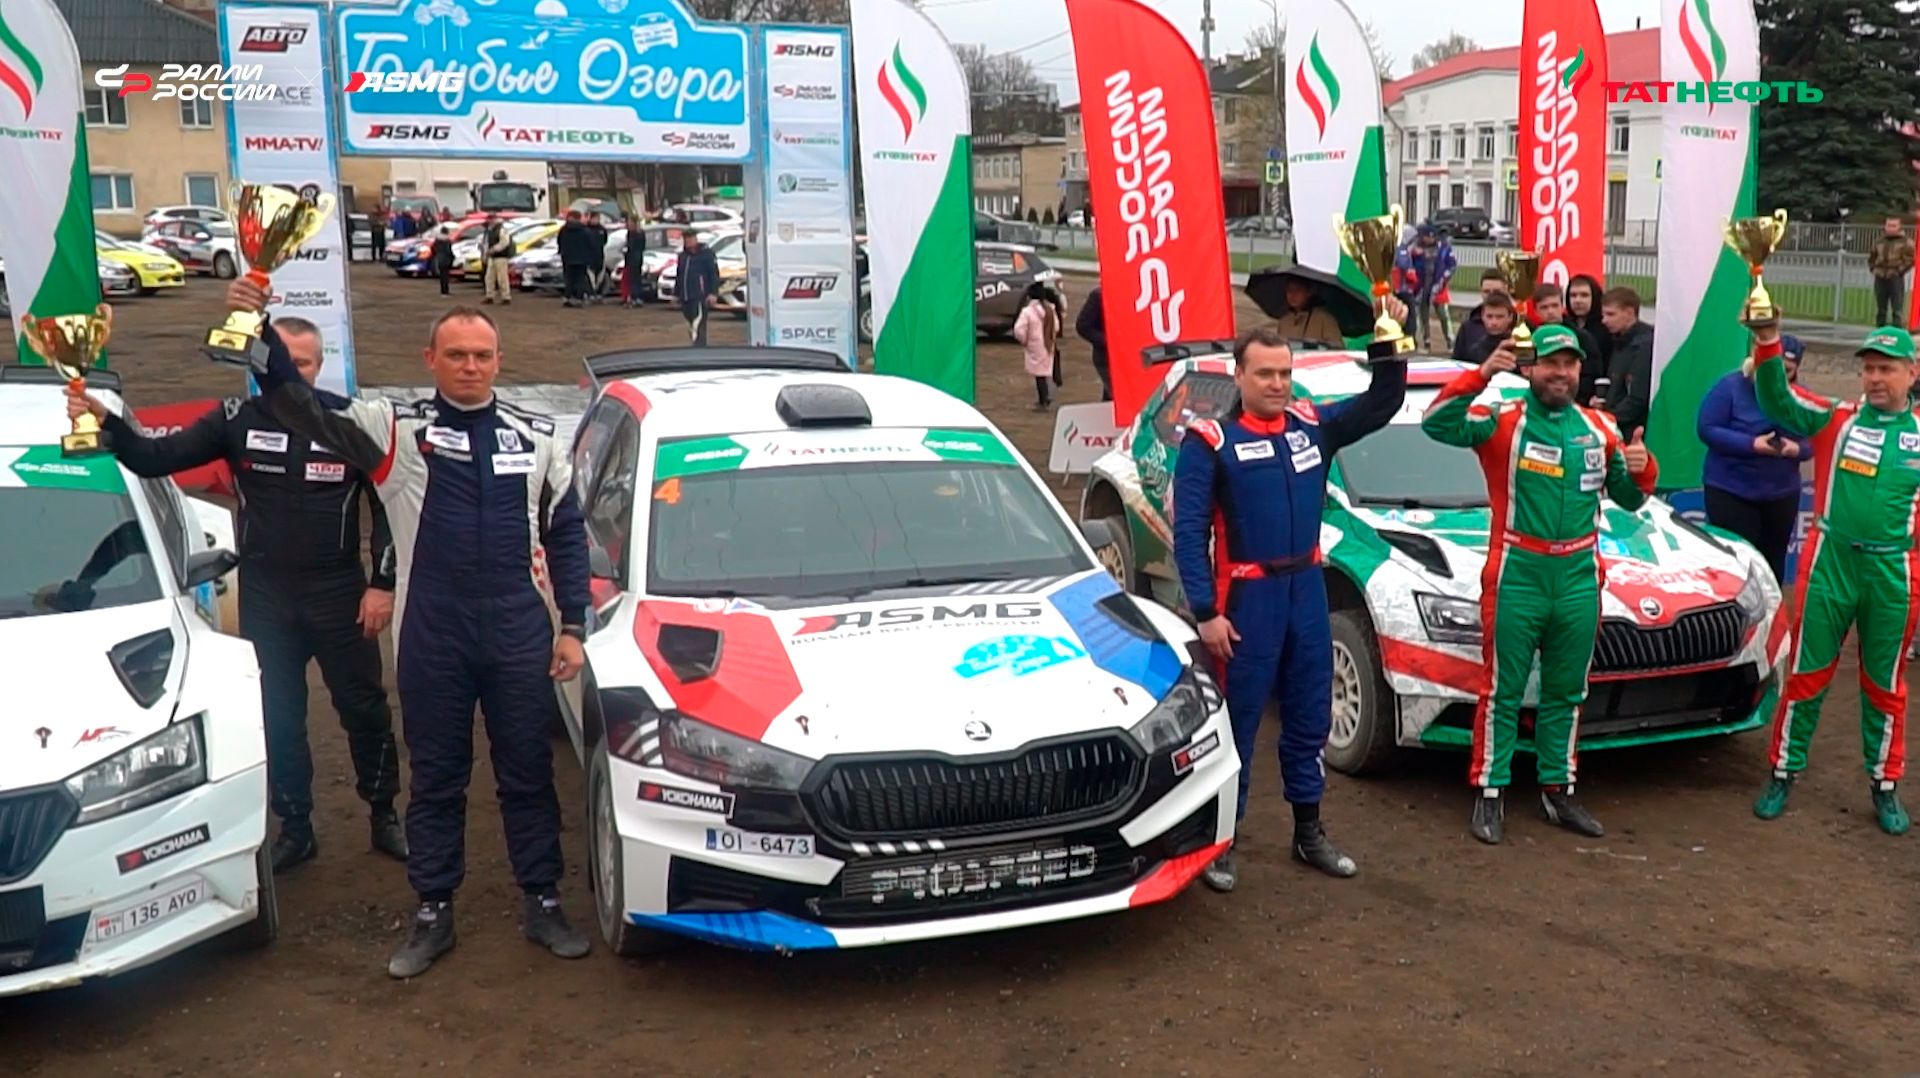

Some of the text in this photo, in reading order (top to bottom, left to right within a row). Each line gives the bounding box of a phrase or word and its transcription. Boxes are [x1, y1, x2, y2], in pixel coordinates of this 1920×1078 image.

[247, 28, 304, 42] АВТО
[578, 38, 742, 119] Озера
[380, 125, 451, 140] ASMG
[500, 127, 635, 145] ТАТНЕФТЬ
[788, 277, 833, 290] АВТО
[781, 328, 837, 339] SPACE
[654, 477, 682, 505] 4
[828, 602, 1042, 632] ASMG
[661, 788, 726, 812] YOKOHAMA
[143, 829, 205, 861] YOKOHAMA
[129, 902, 160, 927] 136
